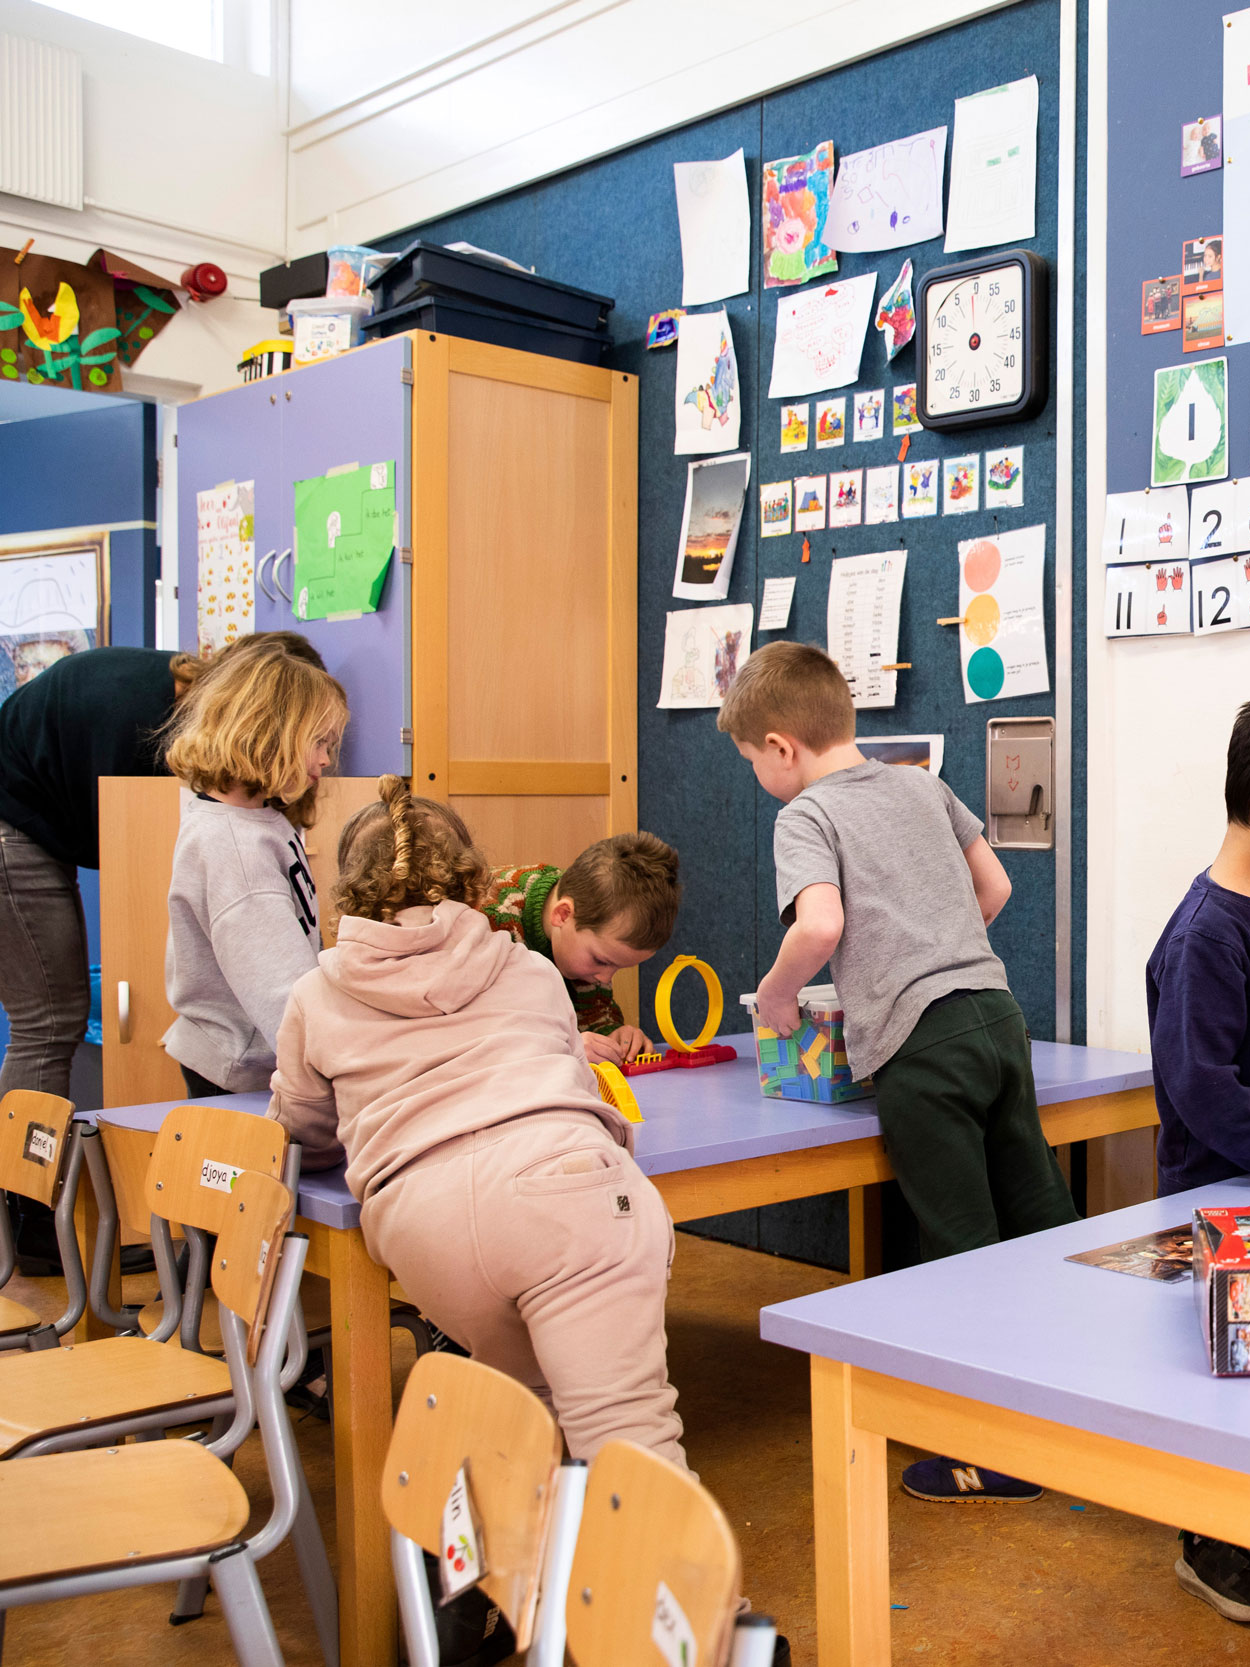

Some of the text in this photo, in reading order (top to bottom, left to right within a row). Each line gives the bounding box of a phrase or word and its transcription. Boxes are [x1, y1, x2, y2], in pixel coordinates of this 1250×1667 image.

[974, 281, 979, 295] 0
[989, 282, 1000, 297] 55
[954, 293, 961, 306] 5
[1004, 299, 1016, 314] 50
[937, 314, 947, 328] 10
[1009, 326, 1021, 341] 45
[931, 343, 942, 357] 15
[1003, 354, 1016, 368] 40
[935, 368, 946, 381] 20
[949, 386, 961, 399] 25
[989, 378, 1001, 393] 35
[969, 388, 980, 403] 30
[1119, 518, 1126, 555] 1
[1200, 510, 1223, 550] 2
[1115, 591, 1133, 630] 11
[1197, 585, 1232, 628] 12
[202, 1163, 228, 1183] djoya
[951, 1466, 984, 1492] N
